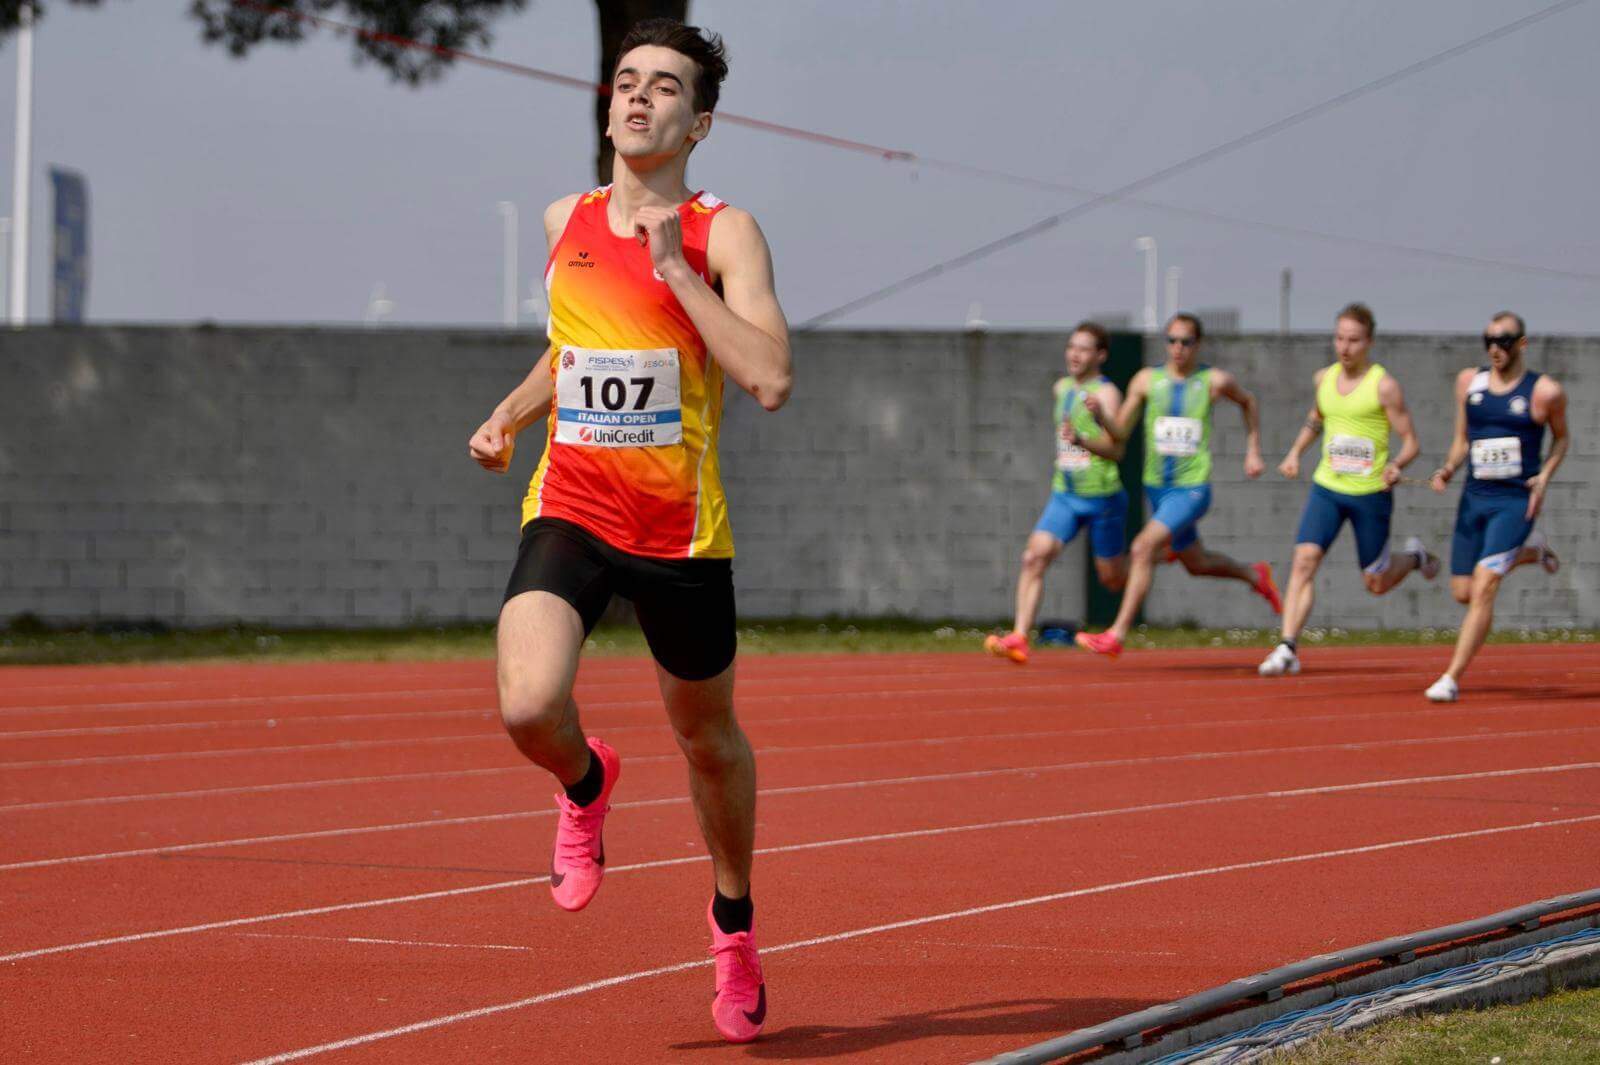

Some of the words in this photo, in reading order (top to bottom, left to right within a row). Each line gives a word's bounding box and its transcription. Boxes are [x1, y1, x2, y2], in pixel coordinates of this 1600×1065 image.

[588, 356, 625, 365] FISPES
[580, 376, 655, 411] 107
[578, 412, 620, 424] ITALIAN
[623, 414, 656, 424] OPEN
[594, 428, 655, 443] UniCredit
